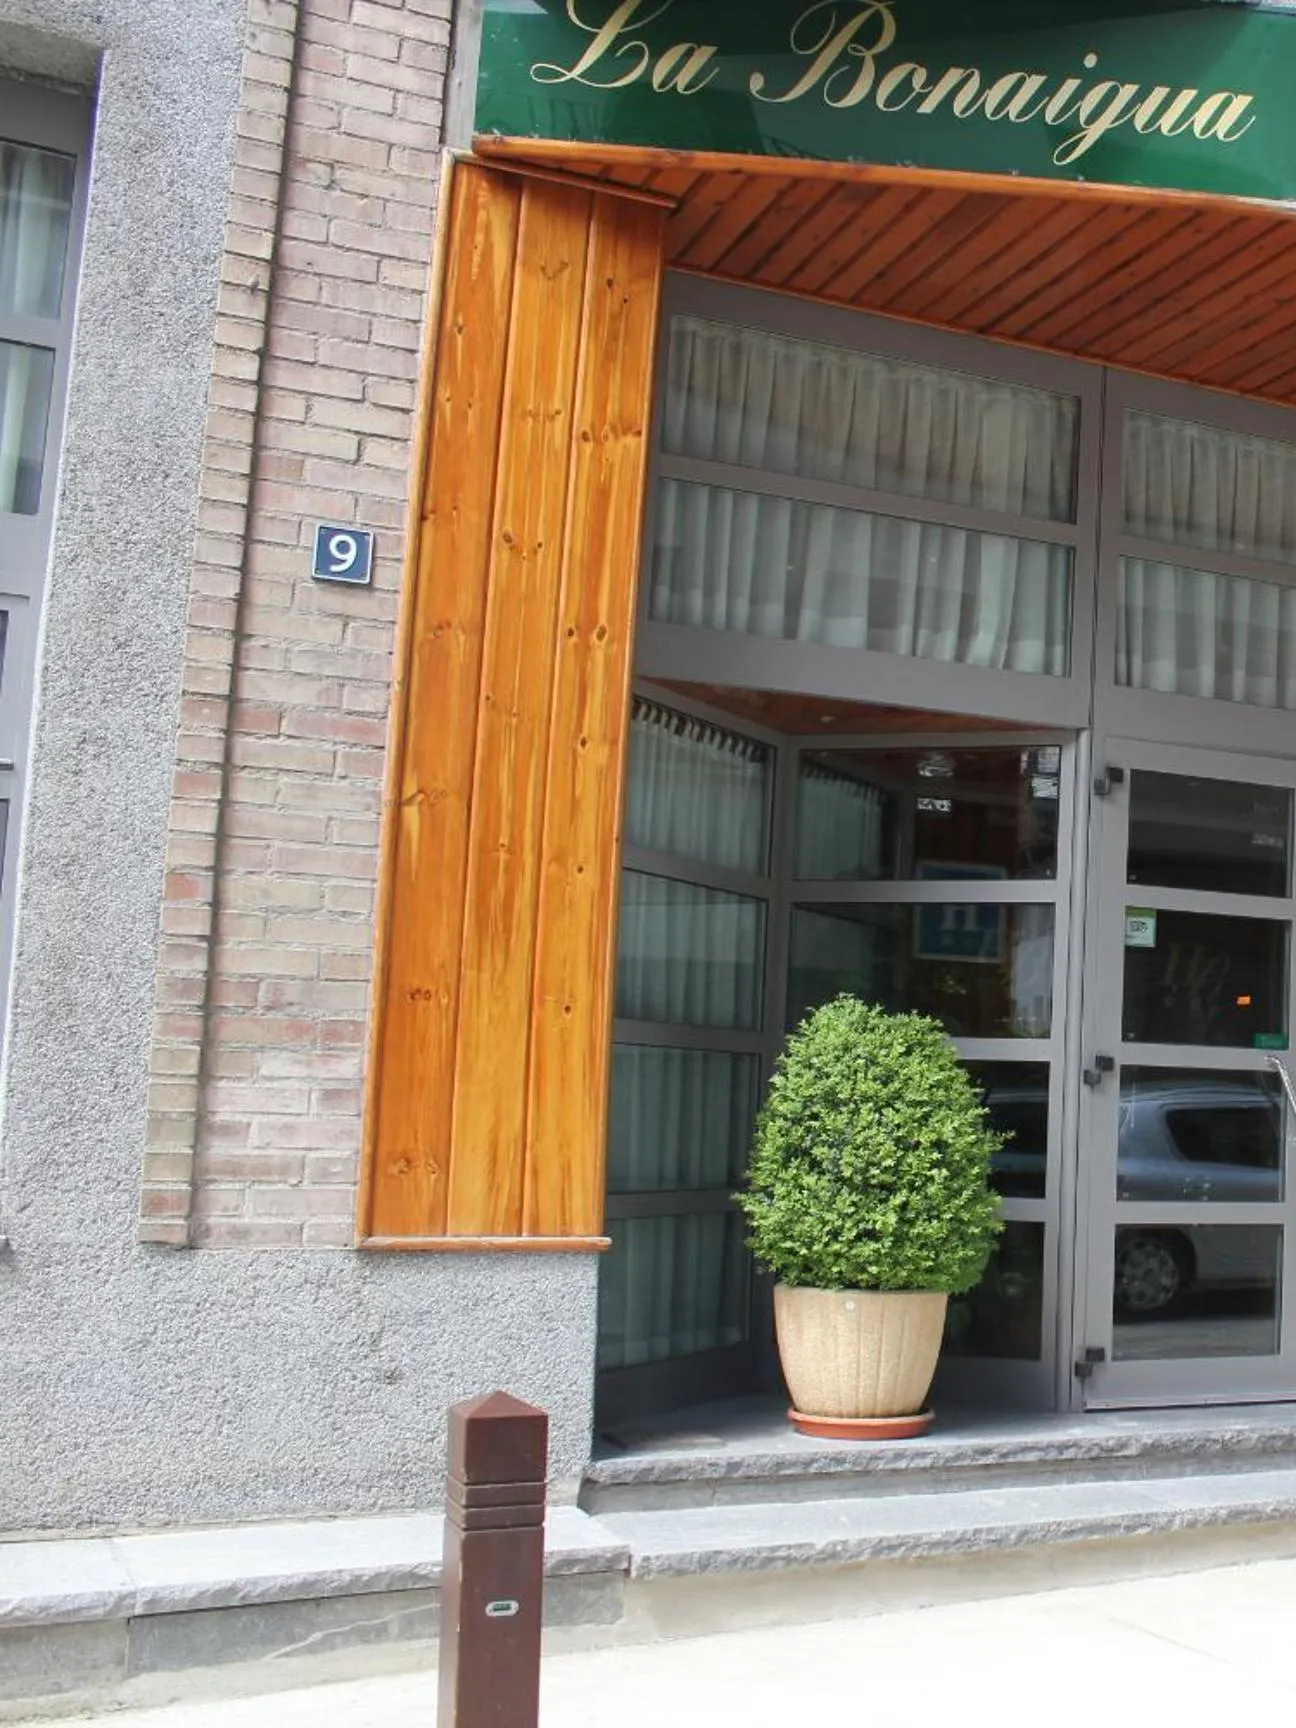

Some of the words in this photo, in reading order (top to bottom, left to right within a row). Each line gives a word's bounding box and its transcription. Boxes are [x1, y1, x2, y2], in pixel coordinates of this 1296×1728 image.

[530, 0, 719, 95] La
[749, 0, 1256, 166] Bonaigua
[329, 534, 357, 573] 9
